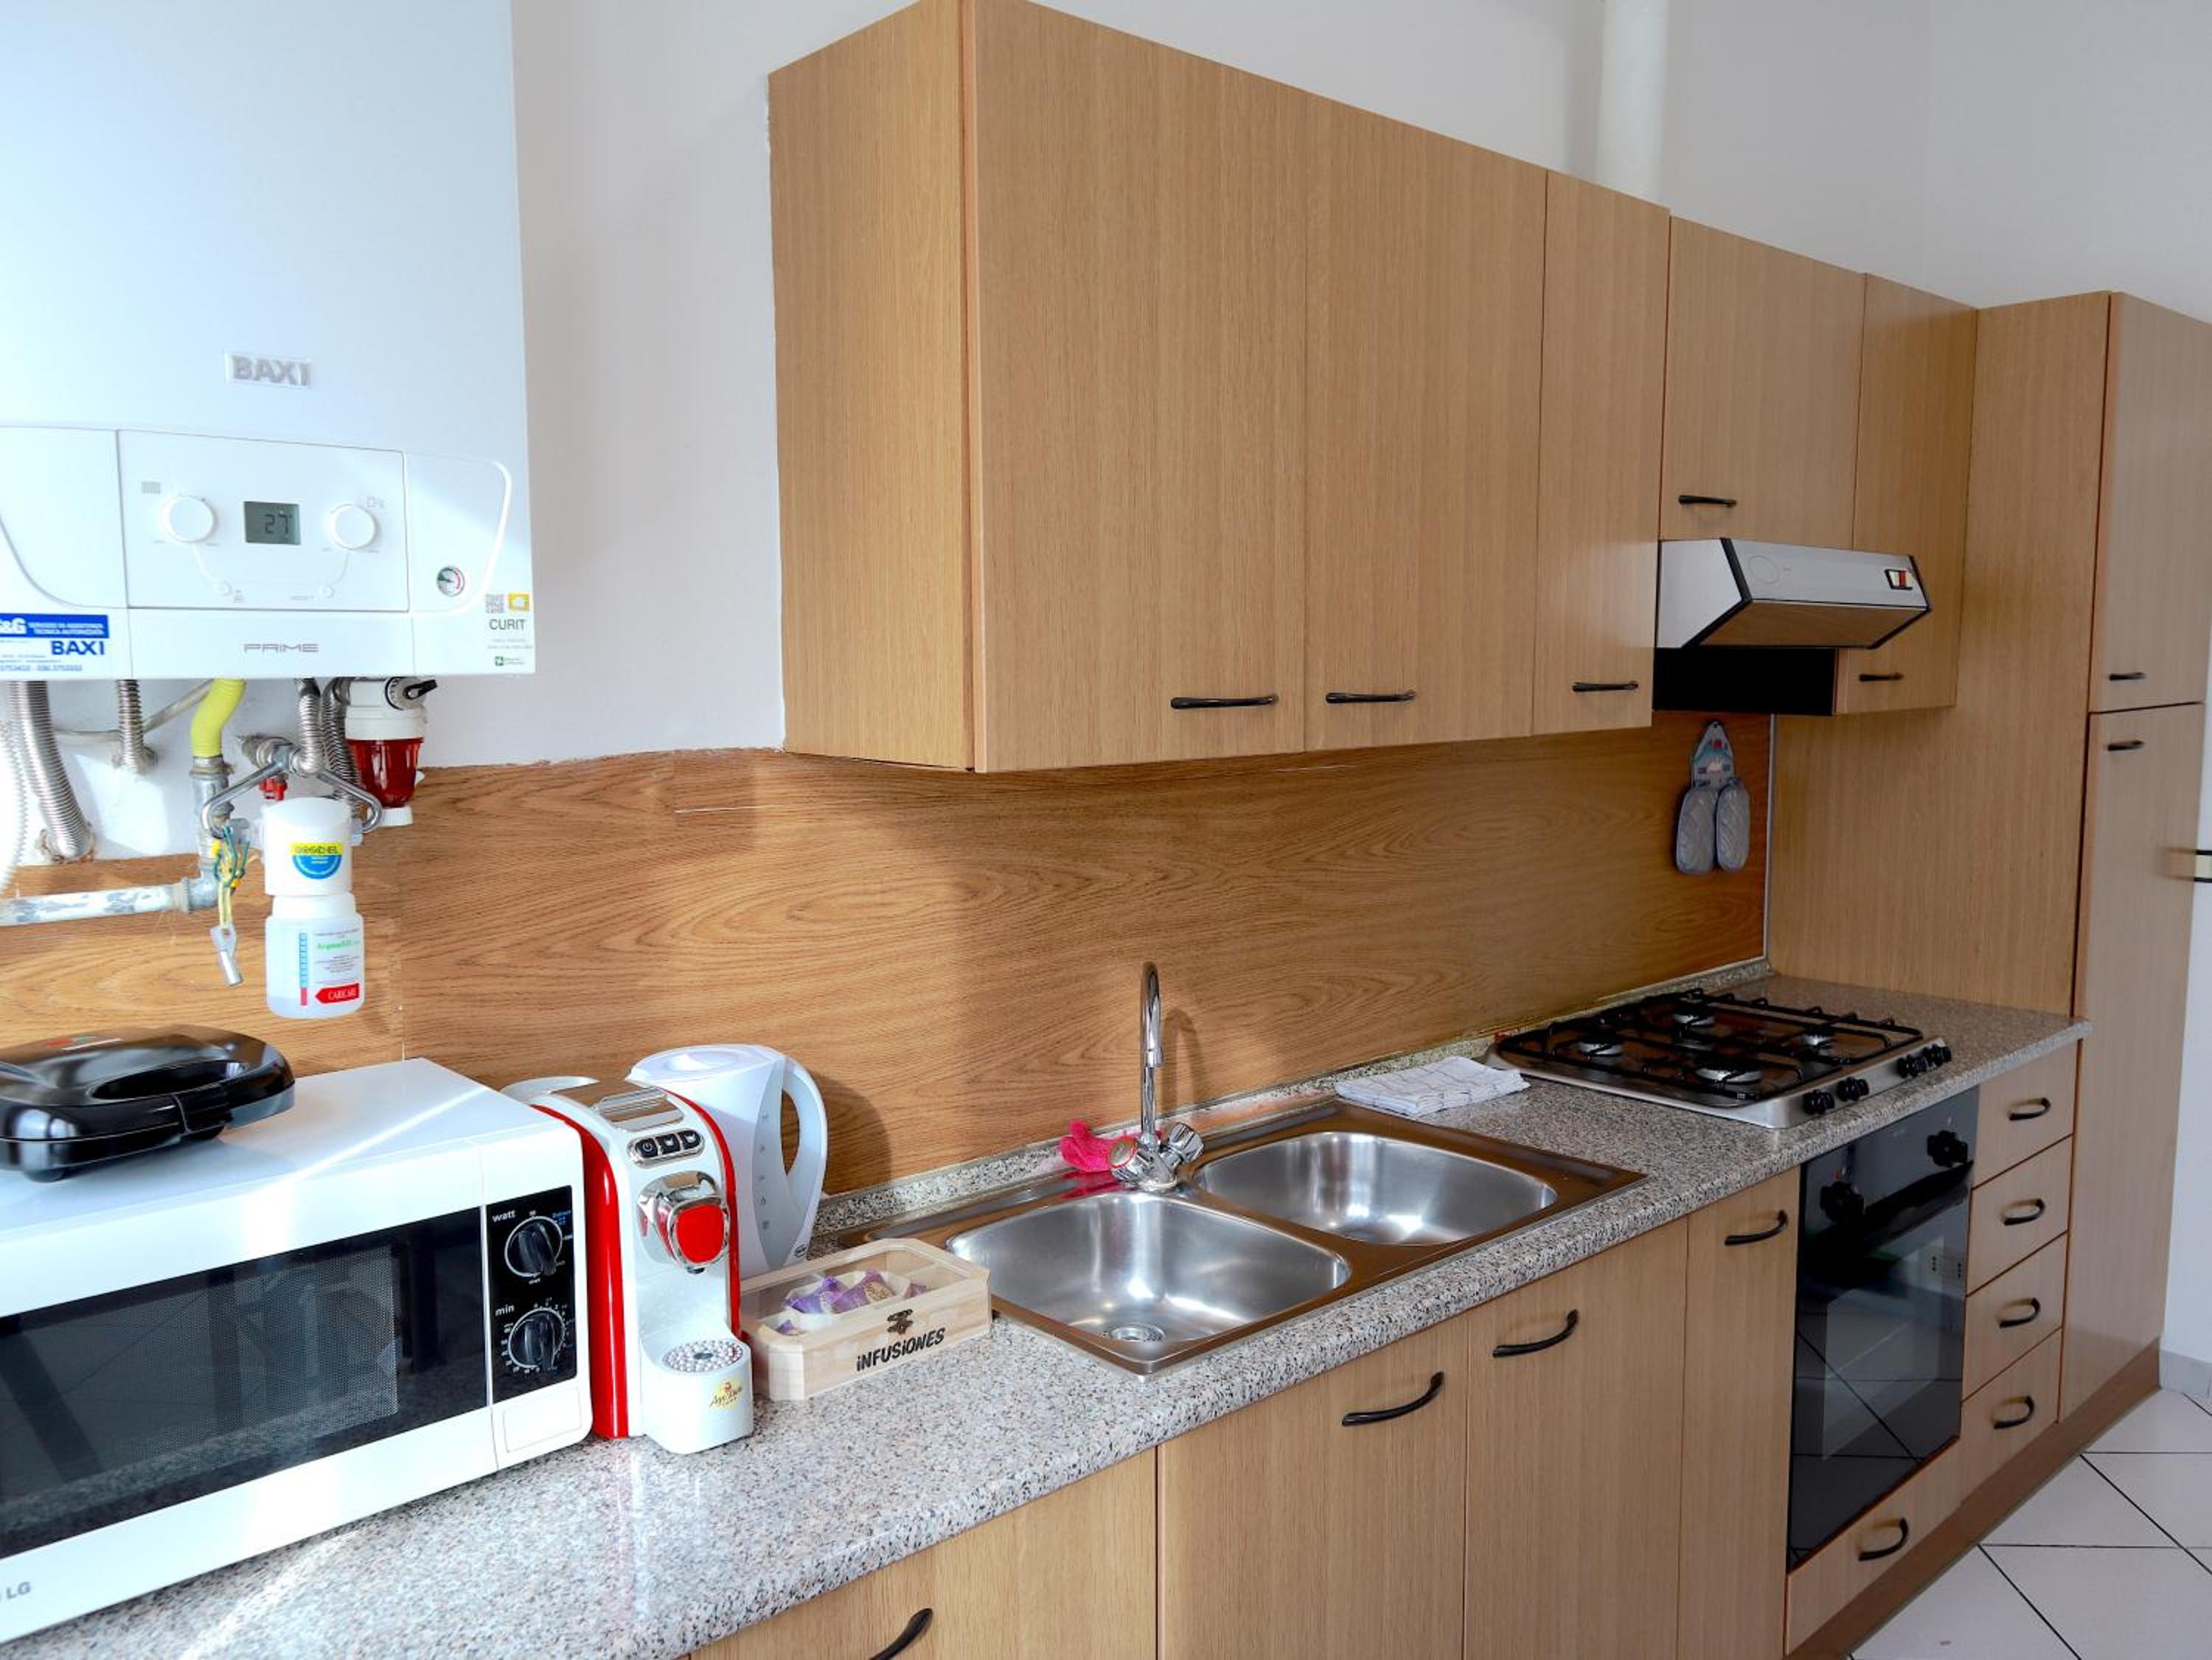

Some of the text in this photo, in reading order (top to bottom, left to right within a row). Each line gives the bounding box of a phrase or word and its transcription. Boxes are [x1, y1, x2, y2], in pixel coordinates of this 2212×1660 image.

[232, 355, 307, 386] BAXI
[0, 617, 27, 635] &G
[489, 618, 526, 630] CURIT
[51, 640, 105, 656] BAXI
[244, 643, 319, 653] PRIME
[492, 1210, 516, 1223] watt
[495, 1304, 515, 1317] min
[6, 1581, 31, 1599] LG
